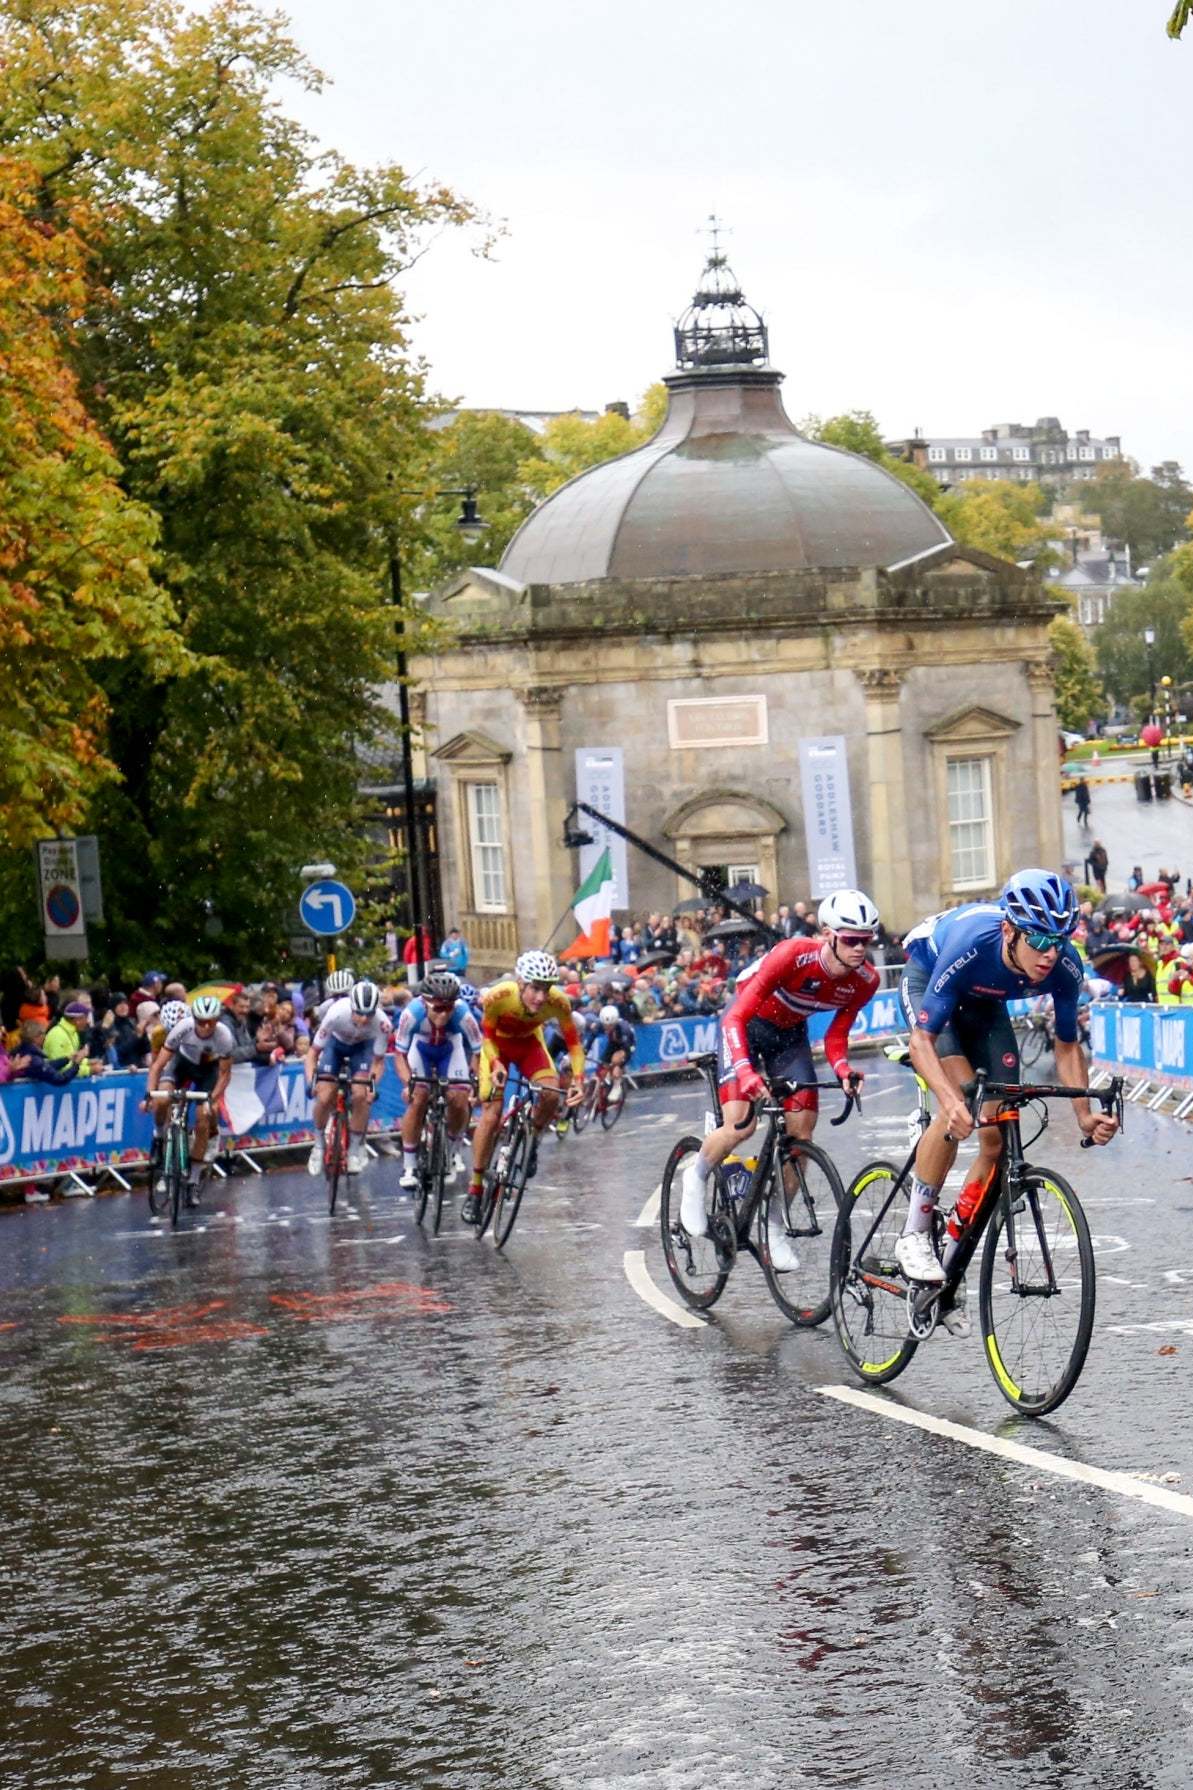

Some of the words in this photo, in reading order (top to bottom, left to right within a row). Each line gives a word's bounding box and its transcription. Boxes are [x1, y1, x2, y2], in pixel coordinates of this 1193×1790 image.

[814, 774, 826, 836] GODDARD
[826, 774, 840, 852] ADDLESHAW
[42, 868, 76, 881] ZONE
[934, 948, 979, 993] CASTELLI
[902, 976, 917, 1029] CASTE
[21, 1088, 127, 1153] MAPEI
